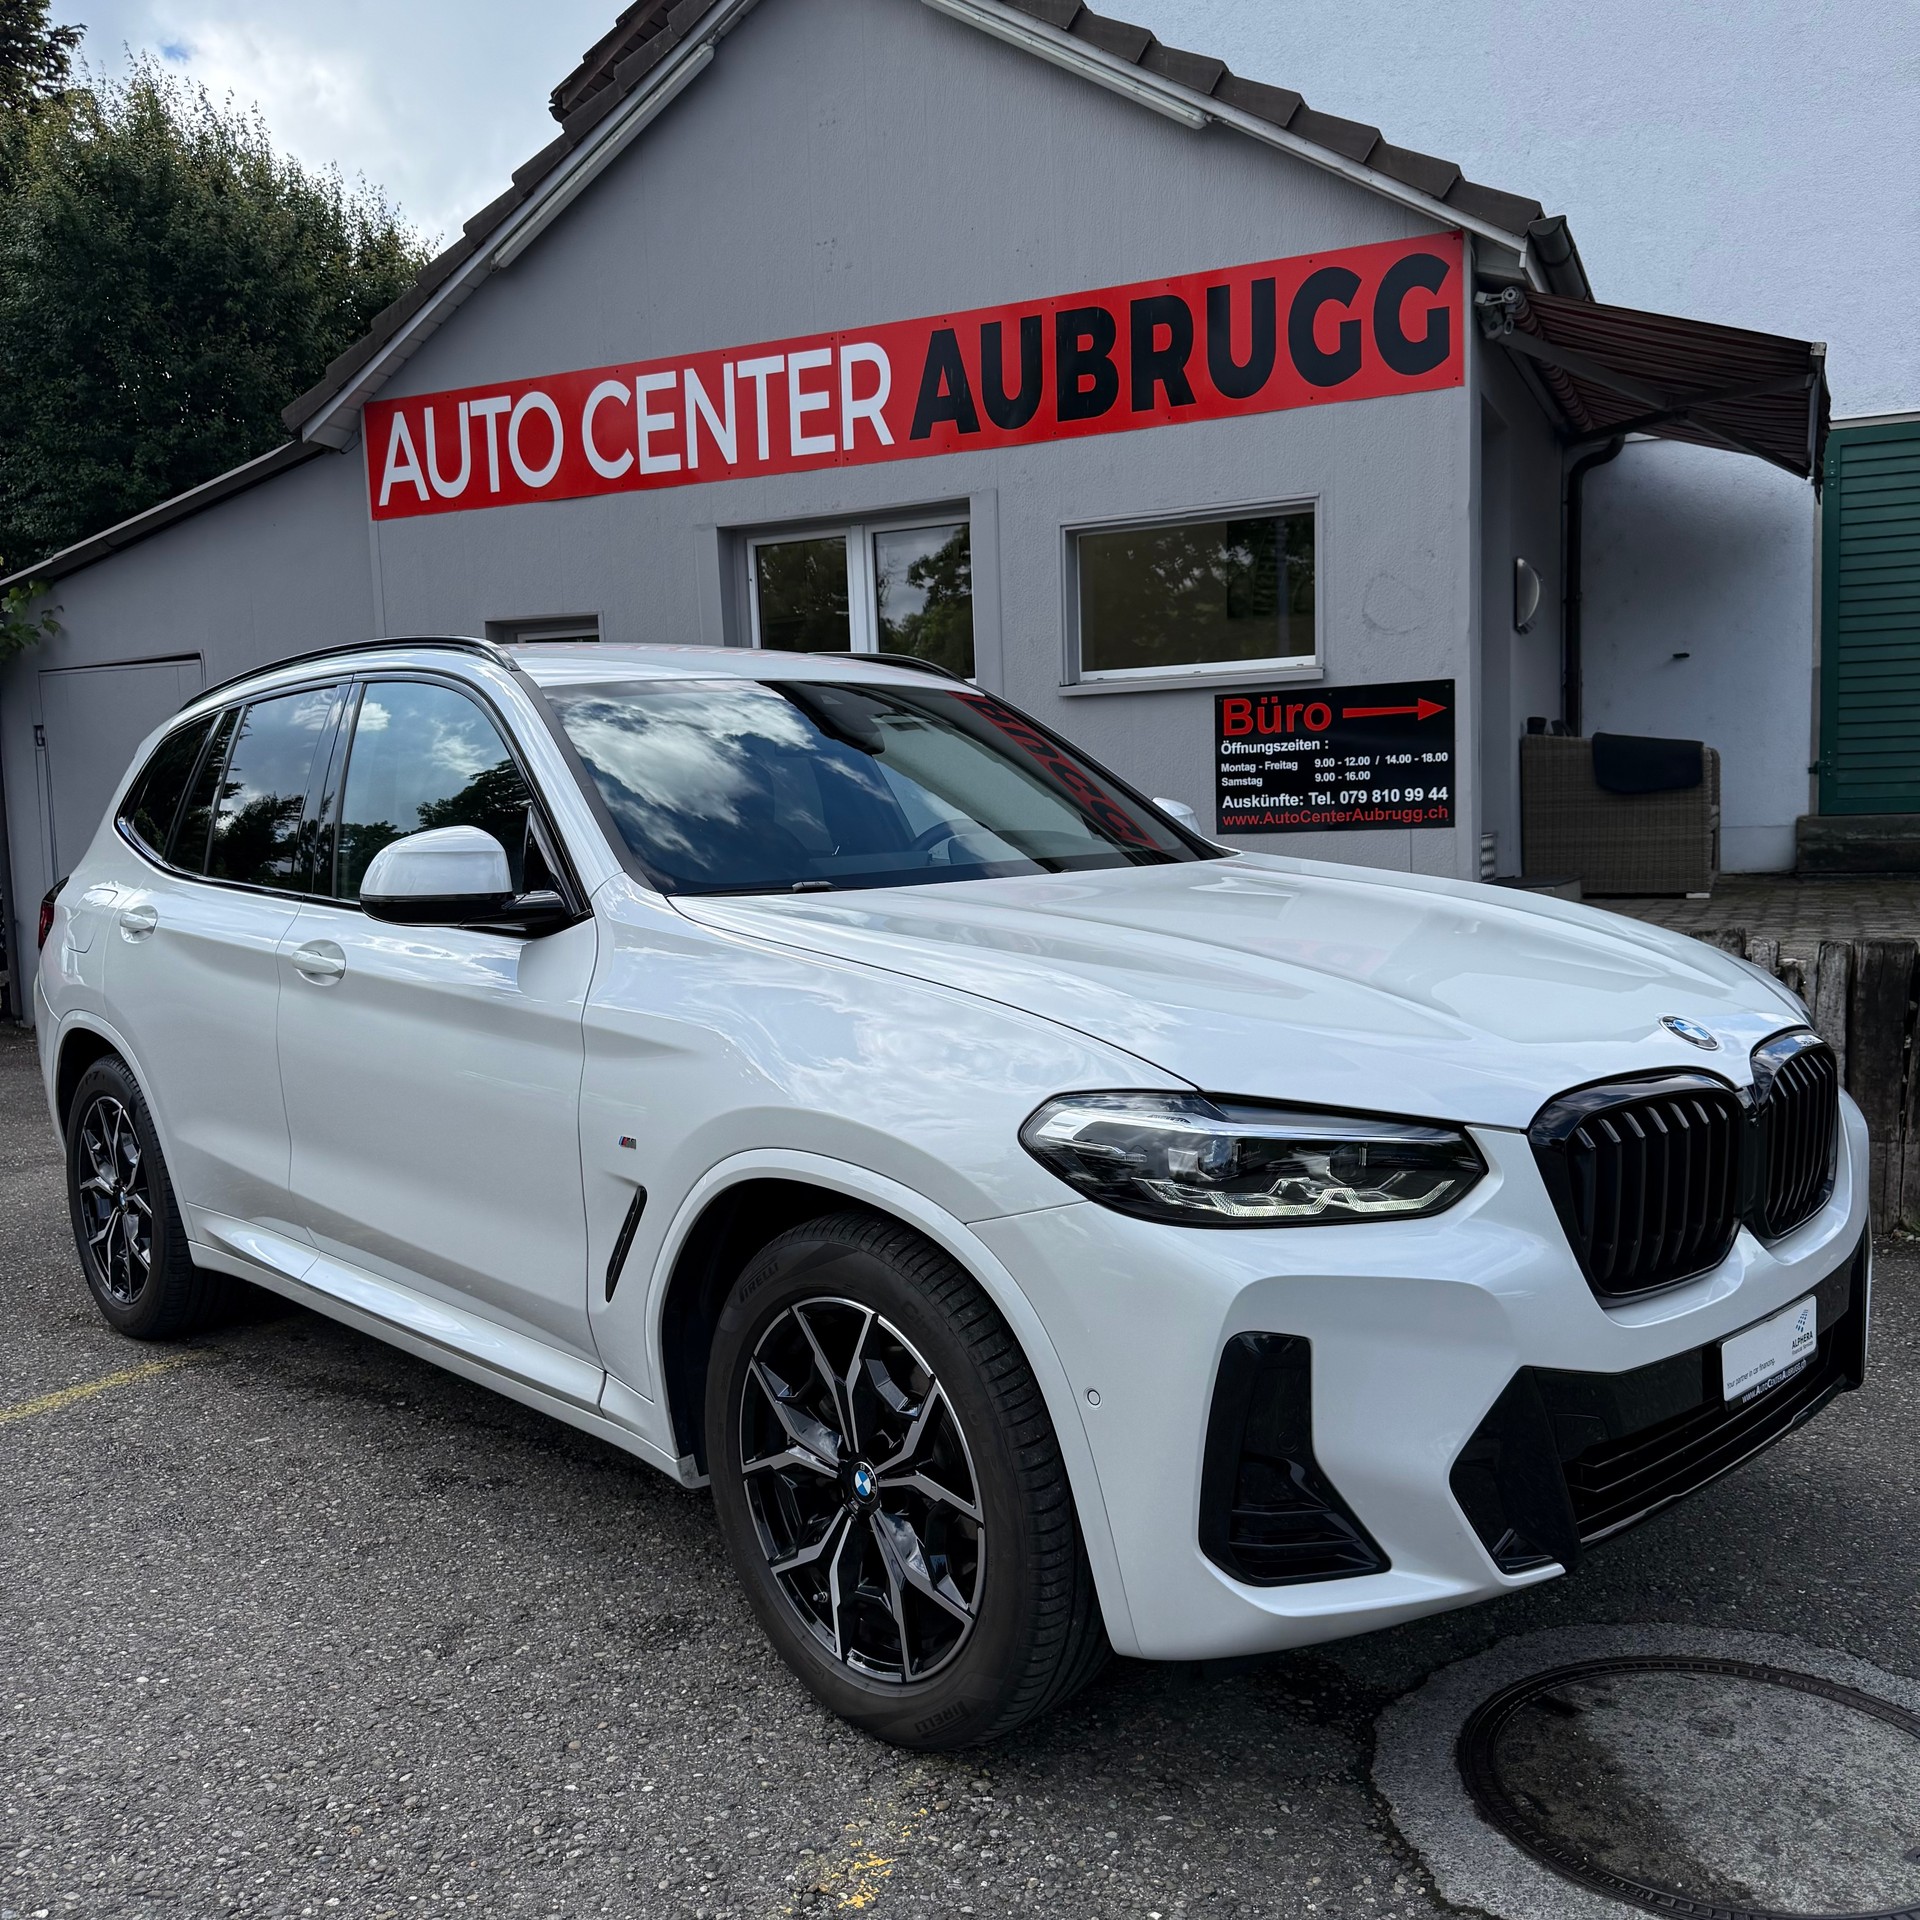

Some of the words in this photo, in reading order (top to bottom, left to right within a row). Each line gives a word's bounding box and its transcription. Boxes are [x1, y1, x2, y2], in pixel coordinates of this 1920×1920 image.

[379, 391, 564, 506] AUTO
[582, 342, 895, 479] CENTER
[909, 252, 1451, 440] AUBRUGG
[1223, 696, 1332, 736] Büro
[1221, 763, 1256, 773] Montag
[1264, 760, 1298, 771] Freitag
[1314, 758, 1335, 768] 9.00
[1344, 756, 1371, 766] 12.00
[1375, 755, 1380, 765] /
[1385, 754, 1412, 764] 14.00
[1421, 752, 1449, 763] 18.00
[1221, 777, 1263, 787] Samstag
[1315, 773, 1336, 782] 9.00
[1344, 771, 1371, 781] 16.00
[1222, 794, 1304, 809] Auskünfte:
[1308, 791, 1335, 805] Tel.
[1340, 790, 1368, 804] 079
[1372, 789, 1400, 803] 810
[1404, 788, 1424, 802] 99
[1428, 786, 1449, 801] 44
[1222, 805, 1448, 826] www.AutoCenterAubrugg.ch
[739, 1255, 779, 1303] PIRELLI
[1792, 1331, 1813, 1349] ALPHERA
[1735, 1373, 1749, 1386] partner
[914, 1700, 970, 1738] PIRELLI
